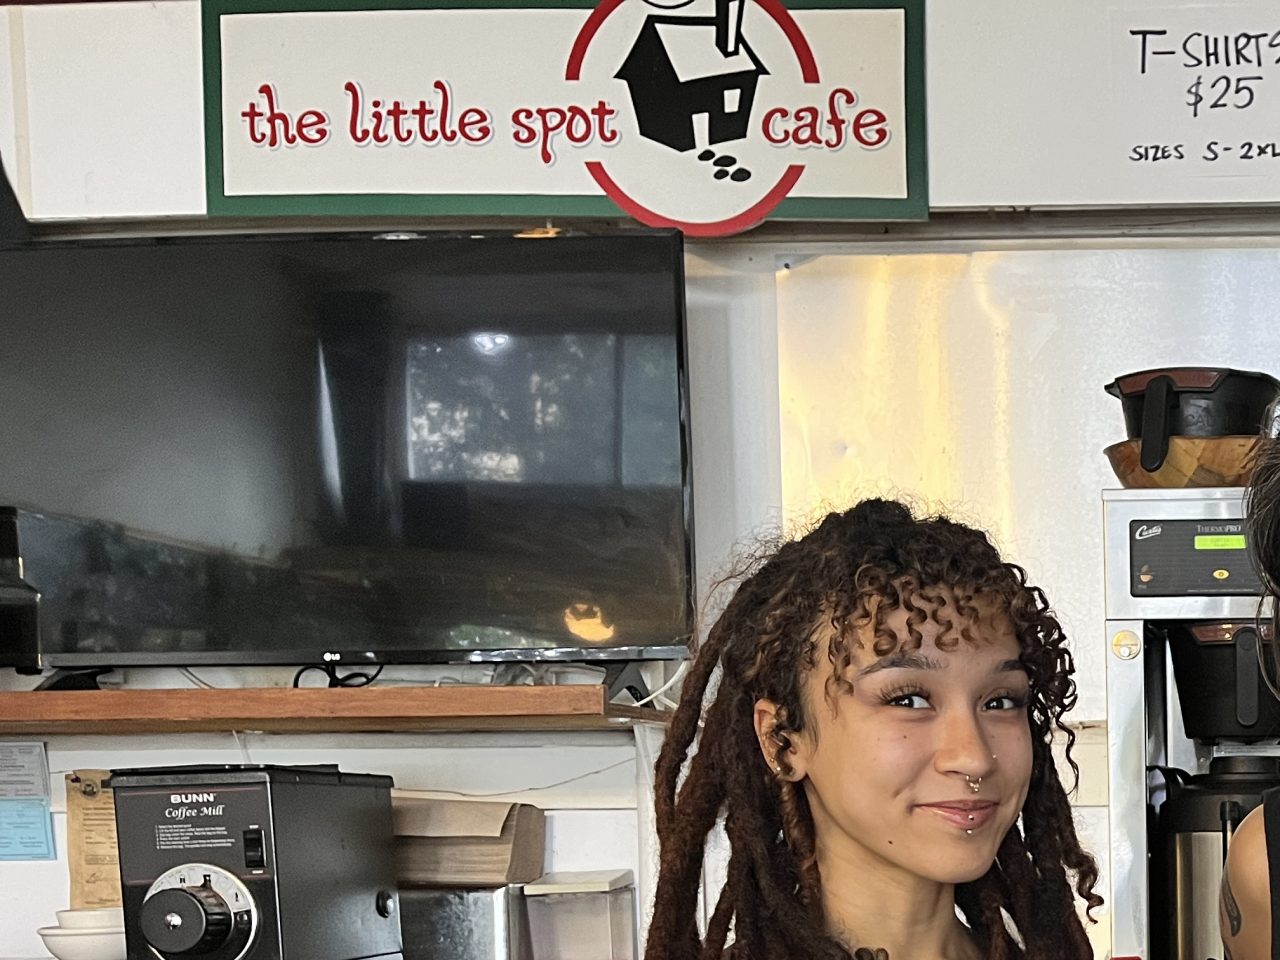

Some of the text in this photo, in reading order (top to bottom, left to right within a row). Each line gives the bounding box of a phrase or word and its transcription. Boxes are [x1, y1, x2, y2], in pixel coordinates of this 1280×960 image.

[1186, 75, 1263, 117] $25
[241, 80, 888, 164] the little spot cafe
[1129, 144, 1184, 161] SIZES
[170, 793, 215, 804] BUNN
[165, 805, 225, 820] Coffee Mill
